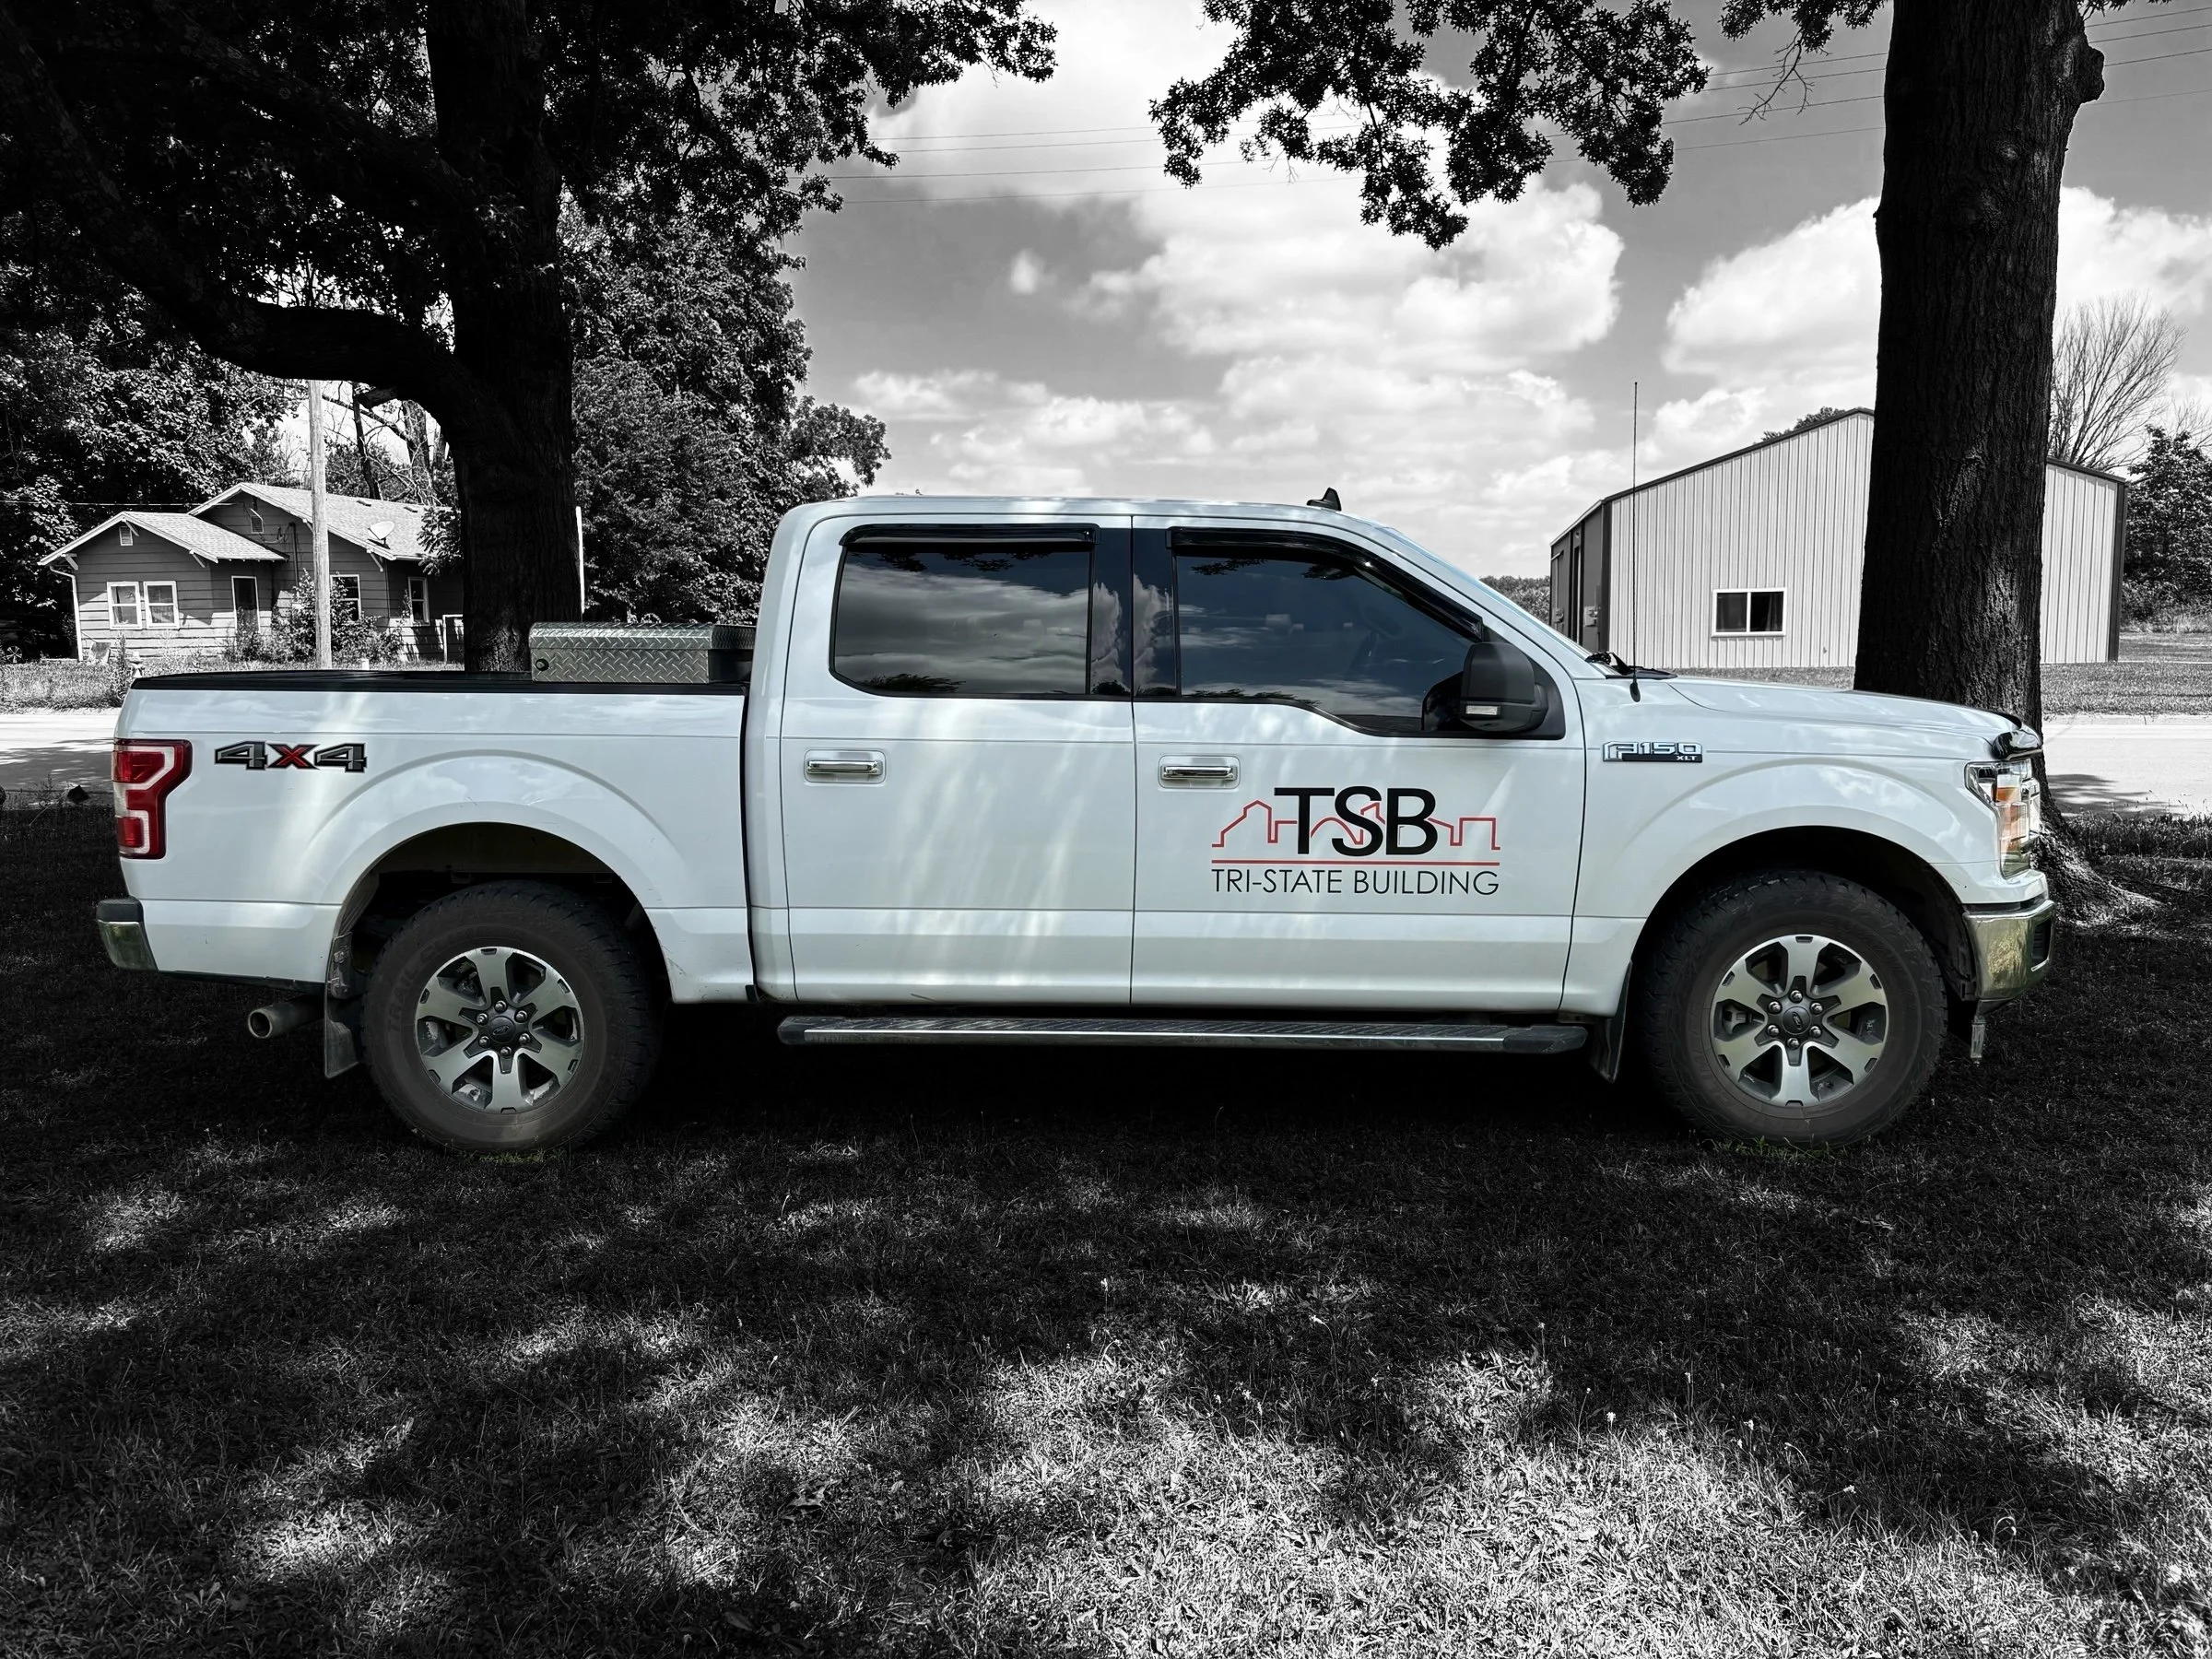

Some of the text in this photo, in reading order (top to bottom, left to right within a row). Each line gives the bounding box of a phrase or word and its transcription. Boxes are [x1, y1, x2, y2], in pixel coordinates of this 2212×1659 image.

[1274, 785, 1439, 857] TSB
[1211, 868, 1500, 896] TRI-STATE BUILDING
